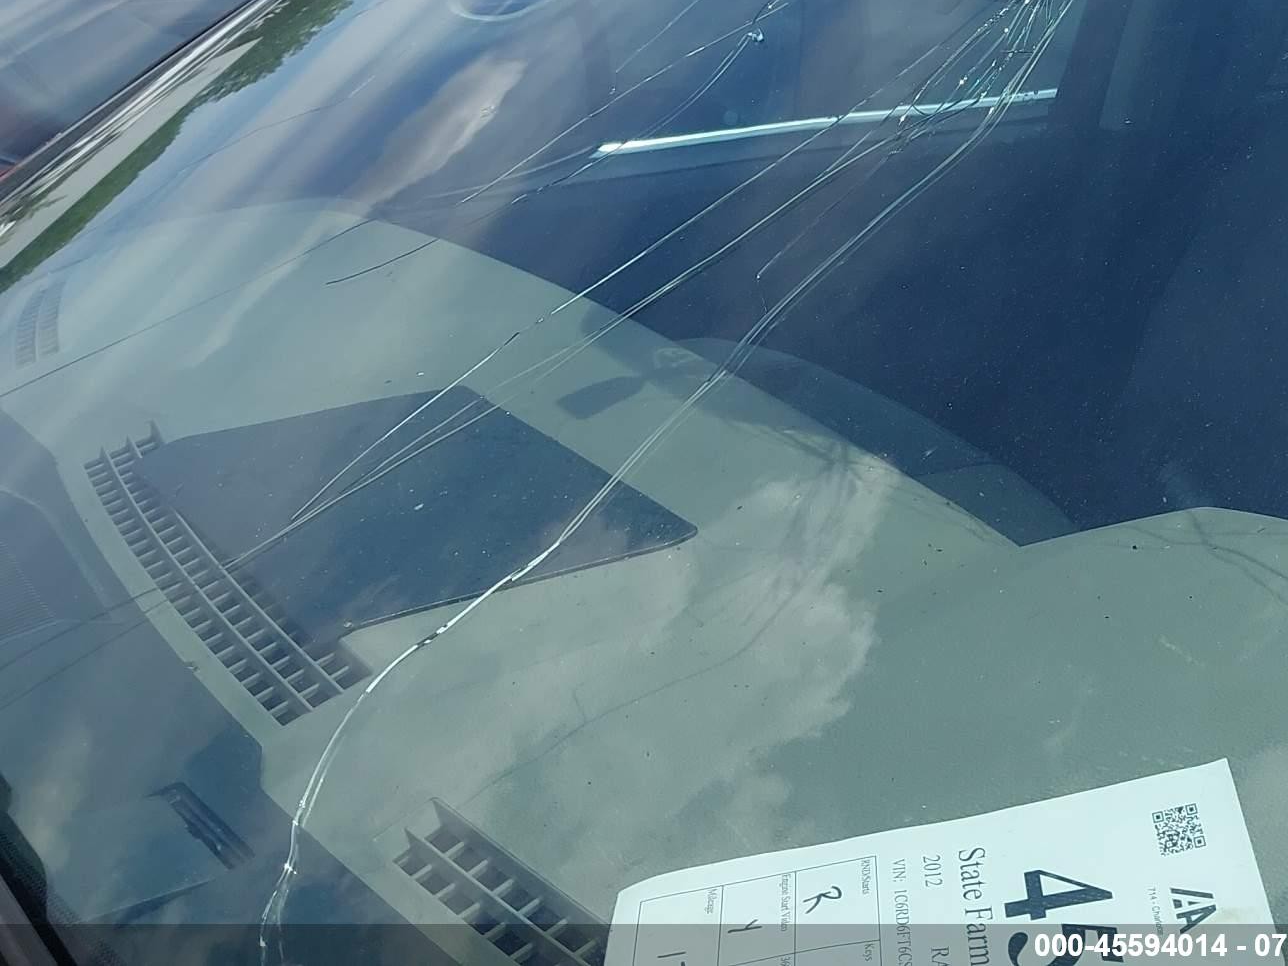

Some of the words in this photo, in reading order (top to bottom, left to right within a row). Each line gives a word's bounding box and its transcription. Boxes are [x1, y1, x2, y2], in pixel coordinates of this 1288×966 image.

[779, 873, 791, 896] Engine
[892, 858, 906, 883] VIN:
[922, 854, 943, 888] 2012
[957, 847, 987, 901] State
[704, 887, 718, 915] Mileage
[780, 895, 791, 911] Start
[802, 885, 843, 915] R
[964, 906, 993, 966] Farm
[863, 943, 874, 962] Keys
